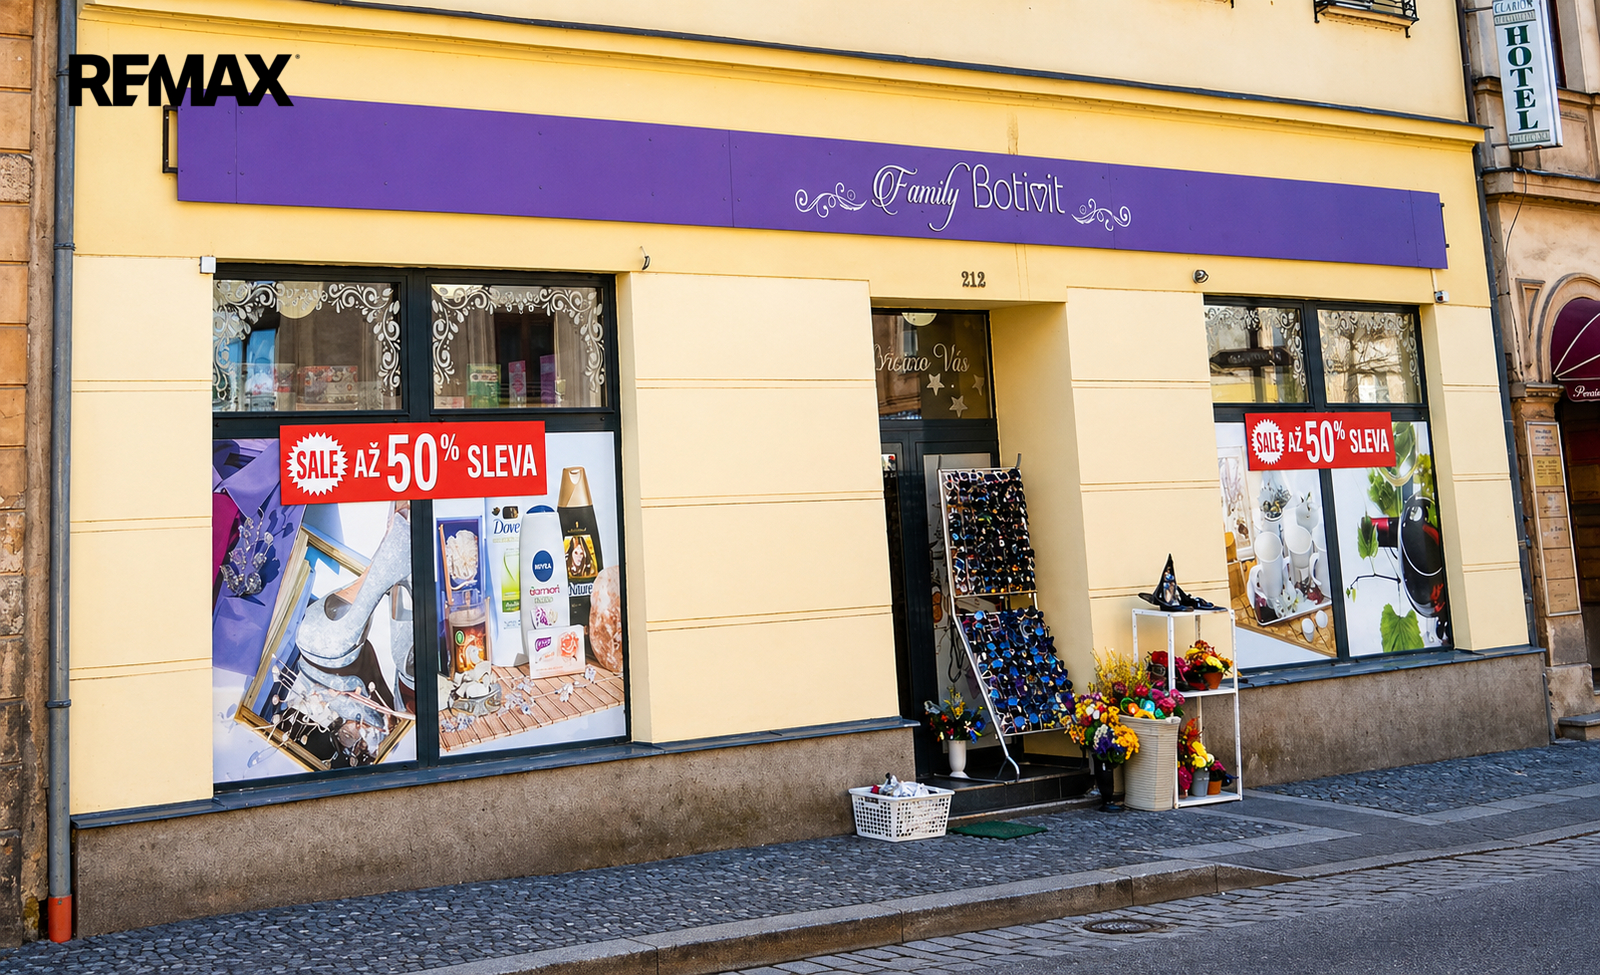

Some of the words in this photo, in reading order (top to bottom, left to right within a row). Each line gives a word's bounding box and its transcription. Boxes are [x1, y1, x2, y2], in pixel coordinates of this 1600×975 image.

[1504, 24, 1539, 131] HOTEL
[871, 162, 971, 232] Family
[972, 163, 1066, 213] Botivit
[961, 271, 986, 288] 212
[933, 343, 970, 373] Vás
[296, 450, 339, 480] SALE
[354, 442, 381, 478] AŽ
[387, 432, 460, 493] 50%
[467, 444, 538, 479] SLEVA
[1256, 431, 1281, 453] SALE
[1288, 426, 1304, 453] AŽ
[1305, 420, 1346, 463] 50%
[1349, 428, 1390, 454] SLEVA
[493, 518, 521, 534] Dove
